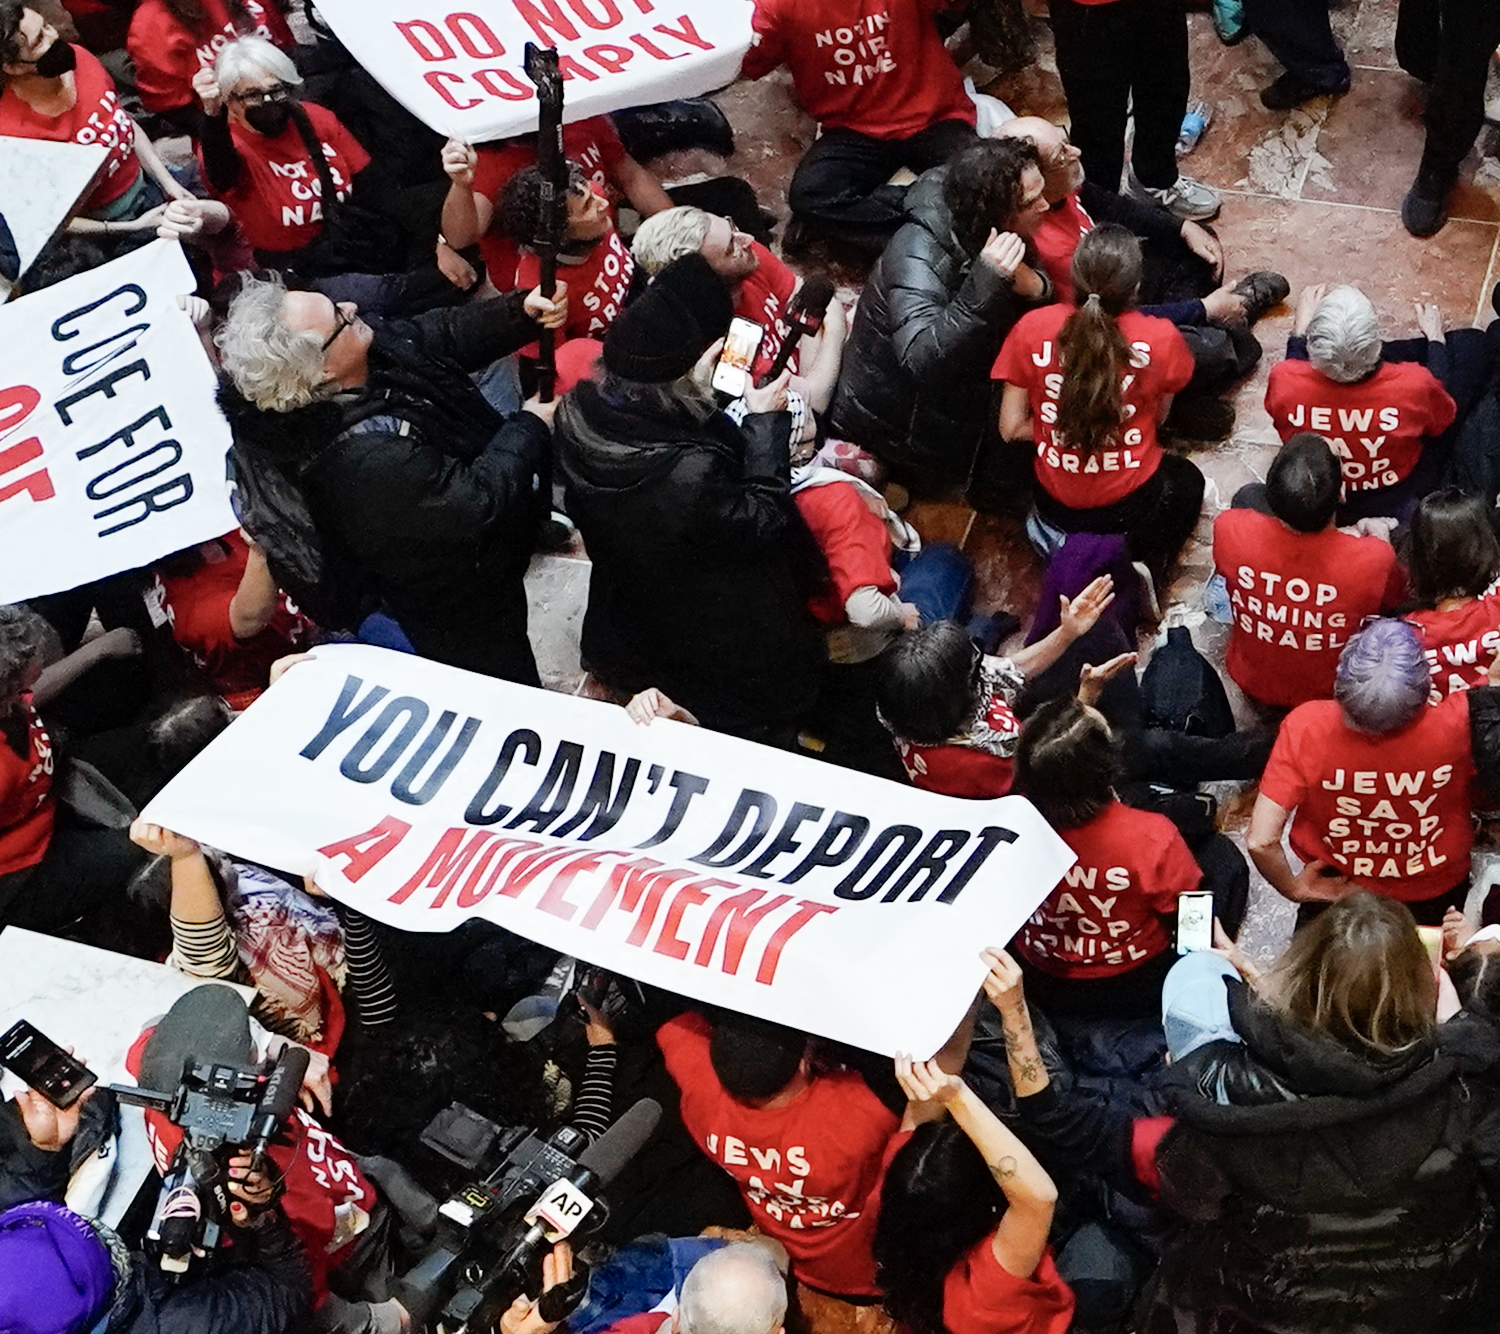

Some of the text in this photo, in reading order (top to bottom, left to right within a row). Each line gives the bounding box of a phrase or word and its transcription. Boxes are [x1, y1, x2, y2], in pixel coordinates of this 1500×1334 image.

[392, 12, 506, 62] DO
[816, 10, 891, 50] NOT IN
[1287, 403, 1400, 433] JEWS
[75, 405, 194, 537] FOR
[1037, 446, 1142, 476] ISRAEL
[1237, 565, 1339, 606] STOP
[1231, 589, 1348, 630] ARMING
[299, 675, 1019, 907] YOU CAN'T DEPORT
[1322, 764, 1454, 797] JEWS
[1336, 793, 1441, 820] SAY
[1328, 816, 1441, 840] STOP
[317, 815, 840, 987] A MOVEMENT
[550, 1187, 584, 1223] AP
